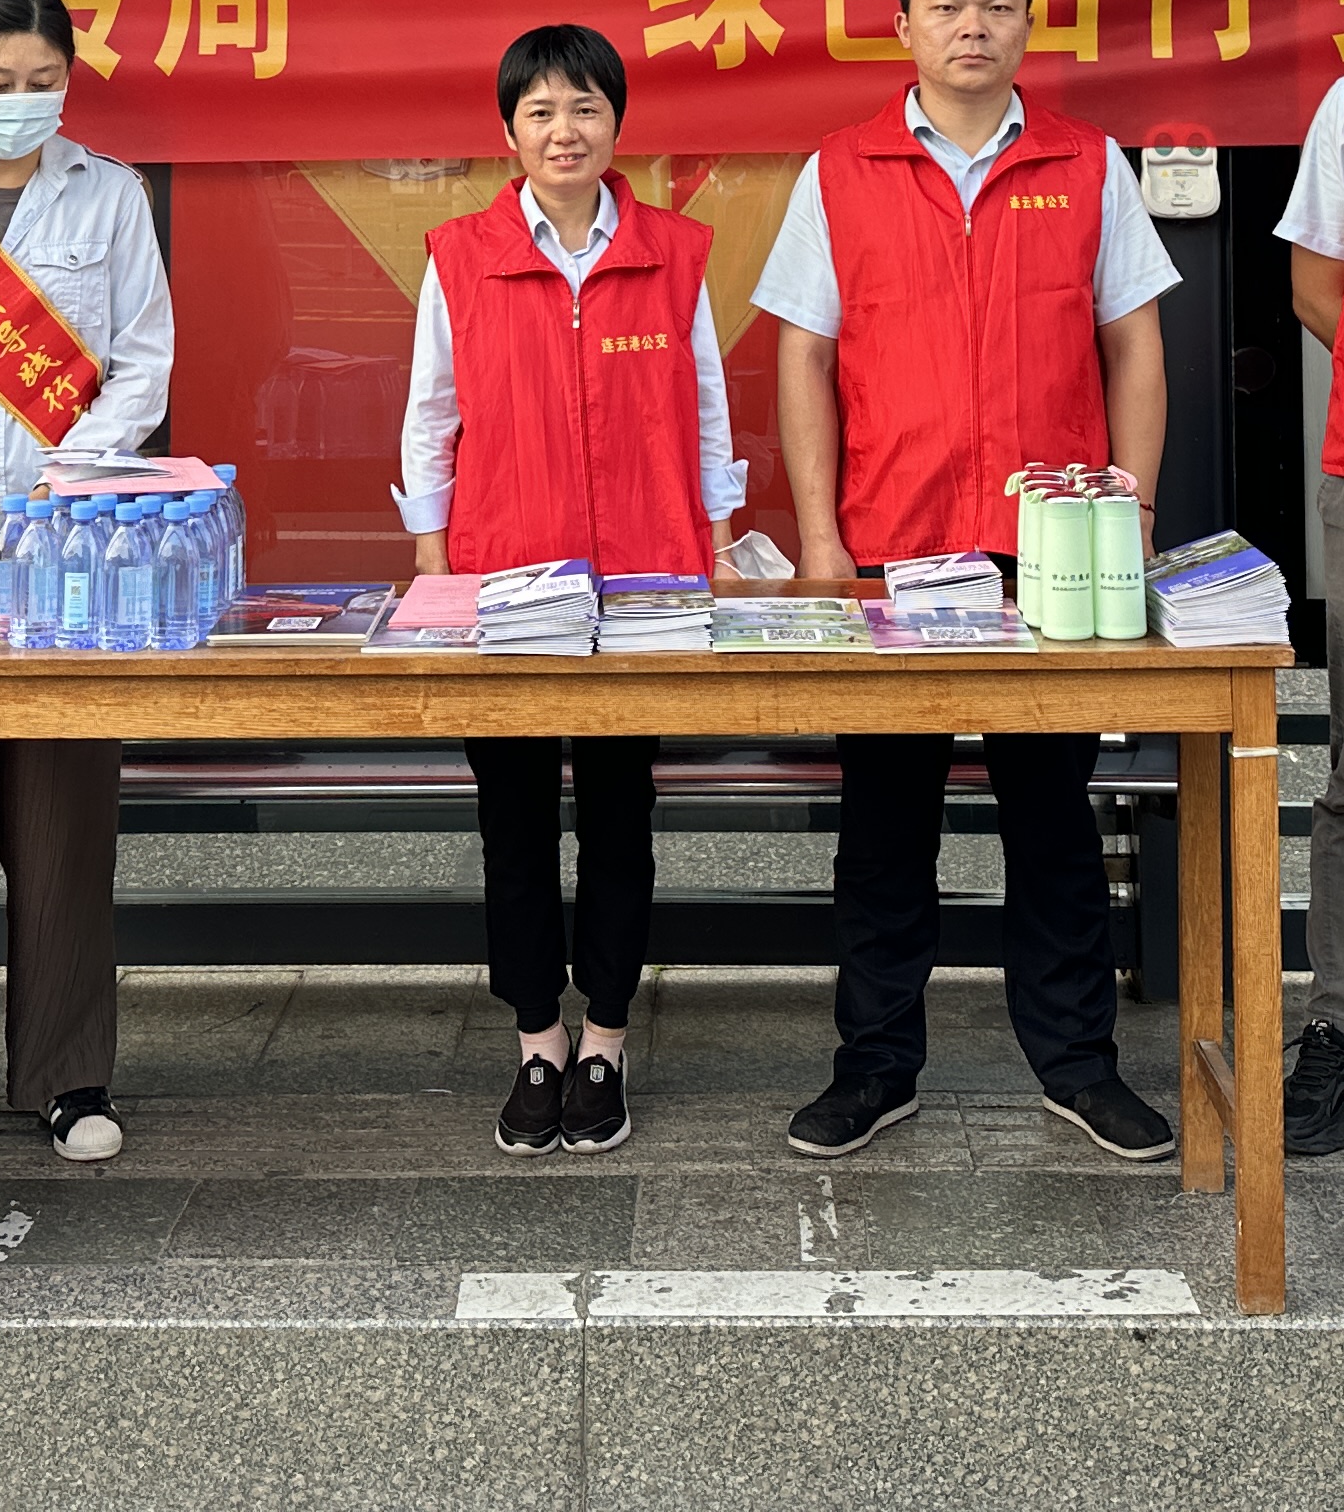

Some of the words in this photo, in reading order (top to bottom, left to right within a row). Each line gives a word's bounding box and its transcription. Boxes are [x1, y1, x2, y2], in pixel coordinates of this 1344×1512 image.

[1009, 193, 1070, 211] 连云港公交
[600, 332, 669, 355] 连云港公交
